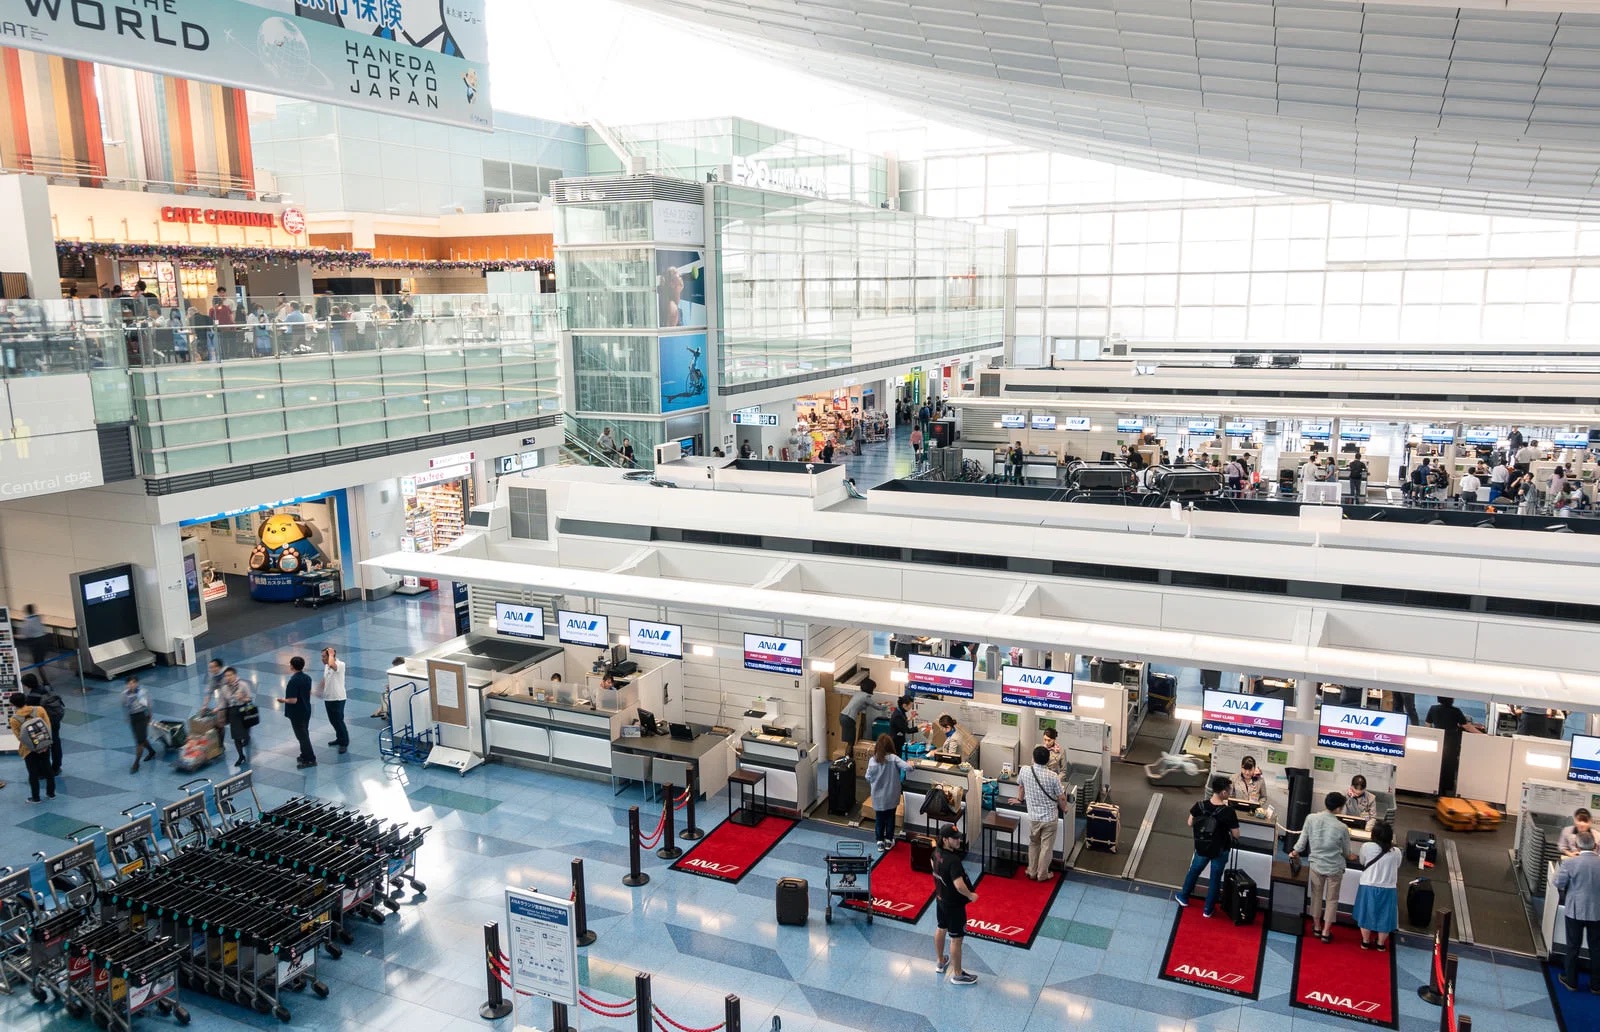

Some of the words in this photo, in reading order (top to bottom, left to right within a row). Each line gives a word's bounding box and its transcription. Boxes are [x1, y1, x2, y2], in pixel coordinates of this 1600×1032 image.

[24, 0, 210, 51] WORLD
[345, 40, 436, 74] HANEDA
[347, 59, 437, 92] TOKYO
[350, 79, 438, 109] JAPAN
[161, 206, 203, 224] CAFE
[204, 209, 277, 228] CARDINAL
[1, 474, 61, 495] Central
[64, 471, 96, 486] 中央
[504, 610, 524, 622] ANA
[566, 619, 587, 630] ANA
[637, 628, 660, 640] ANA
[757, 641, 777, 650] ANA
[923, 661, 945, 673] ANA
[1019, 674, 1042, 685] ANA
[918, 685, 936, 693] minutes
[1027, 698, 1048, 707] check-in
[1049, 701, 1068, 710] process
[1222, 699, 1249, 711] ANA
[1340, 713, 1369, 726] ANA
[1213, 724, 1237, 733] minutes
[1237, 726, 1257, 735] before
[1331, 740, 1349, 748] closes
[1350, 740, 1362, 750] the
[1362, 743, 1388, 753] check-in
[685, 859, 720, 871] ANA
[976, 932, 1008, 944] ALLIANCE
[1174, 964, 1218, 980] ANA
[1175, 977, 1194, 985] STAR
[1195, 981, 1232, 993] ALLIANCE
[1305, 991, 1353, 1009] ANA
[1308, 1005, 1327, 1013] STAR
[1328, 1009, 1369, 1022] ALLIANCE
